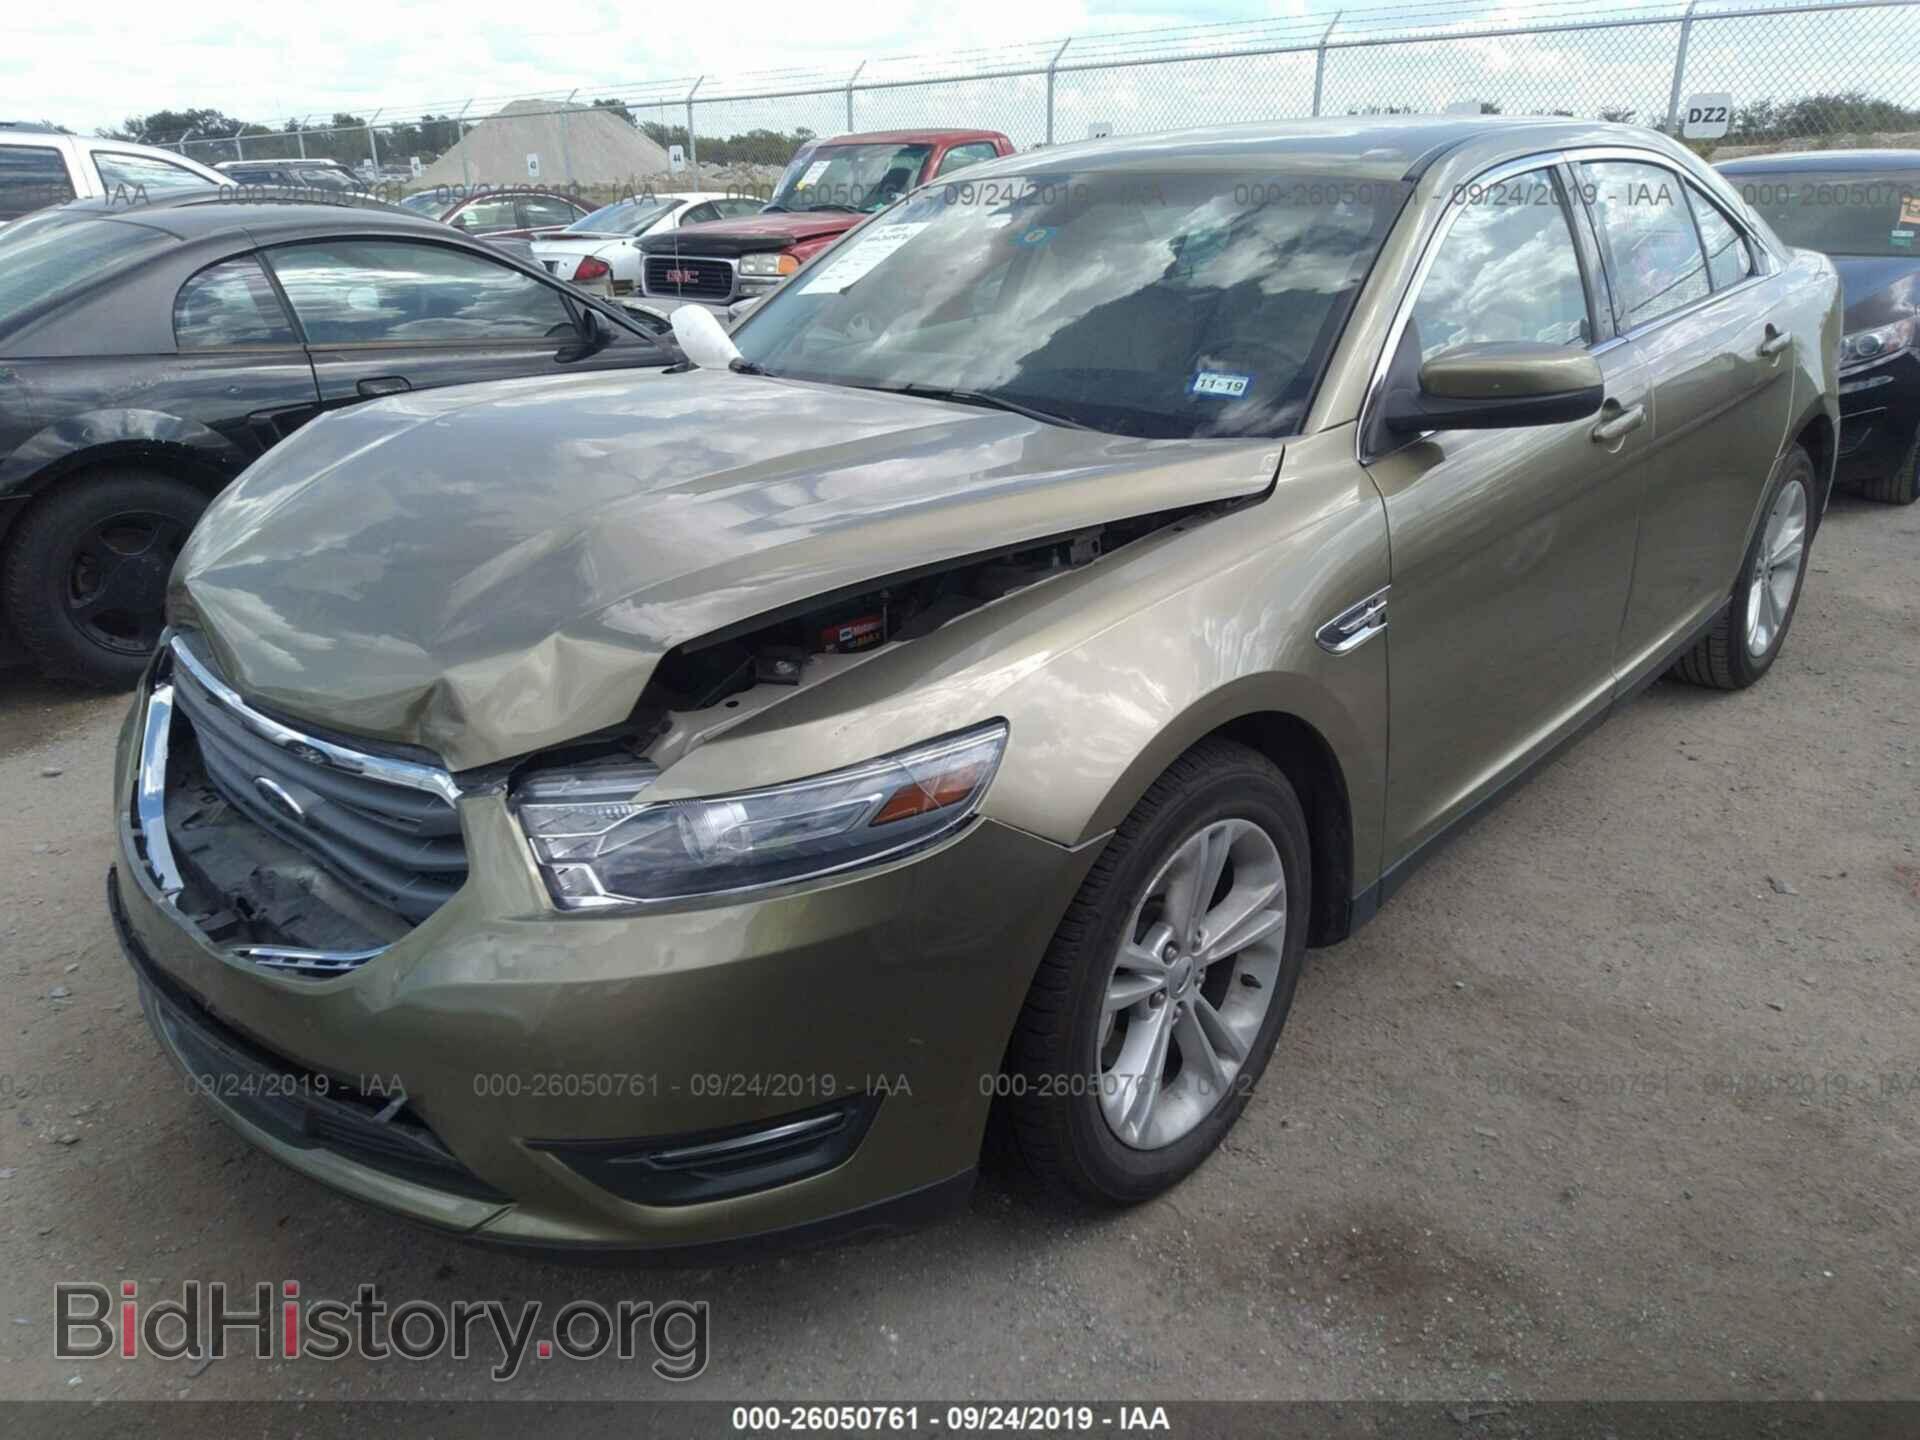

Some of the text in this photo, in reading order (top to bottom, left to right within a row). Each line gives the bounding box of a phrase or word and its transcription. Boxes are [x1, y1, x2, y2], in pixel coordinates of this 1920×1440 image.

[1688, 107, 1727, 123] DZ2
[666, 269, 699, 283] GMC
[1200, 379, 1244, 392] 11-19
